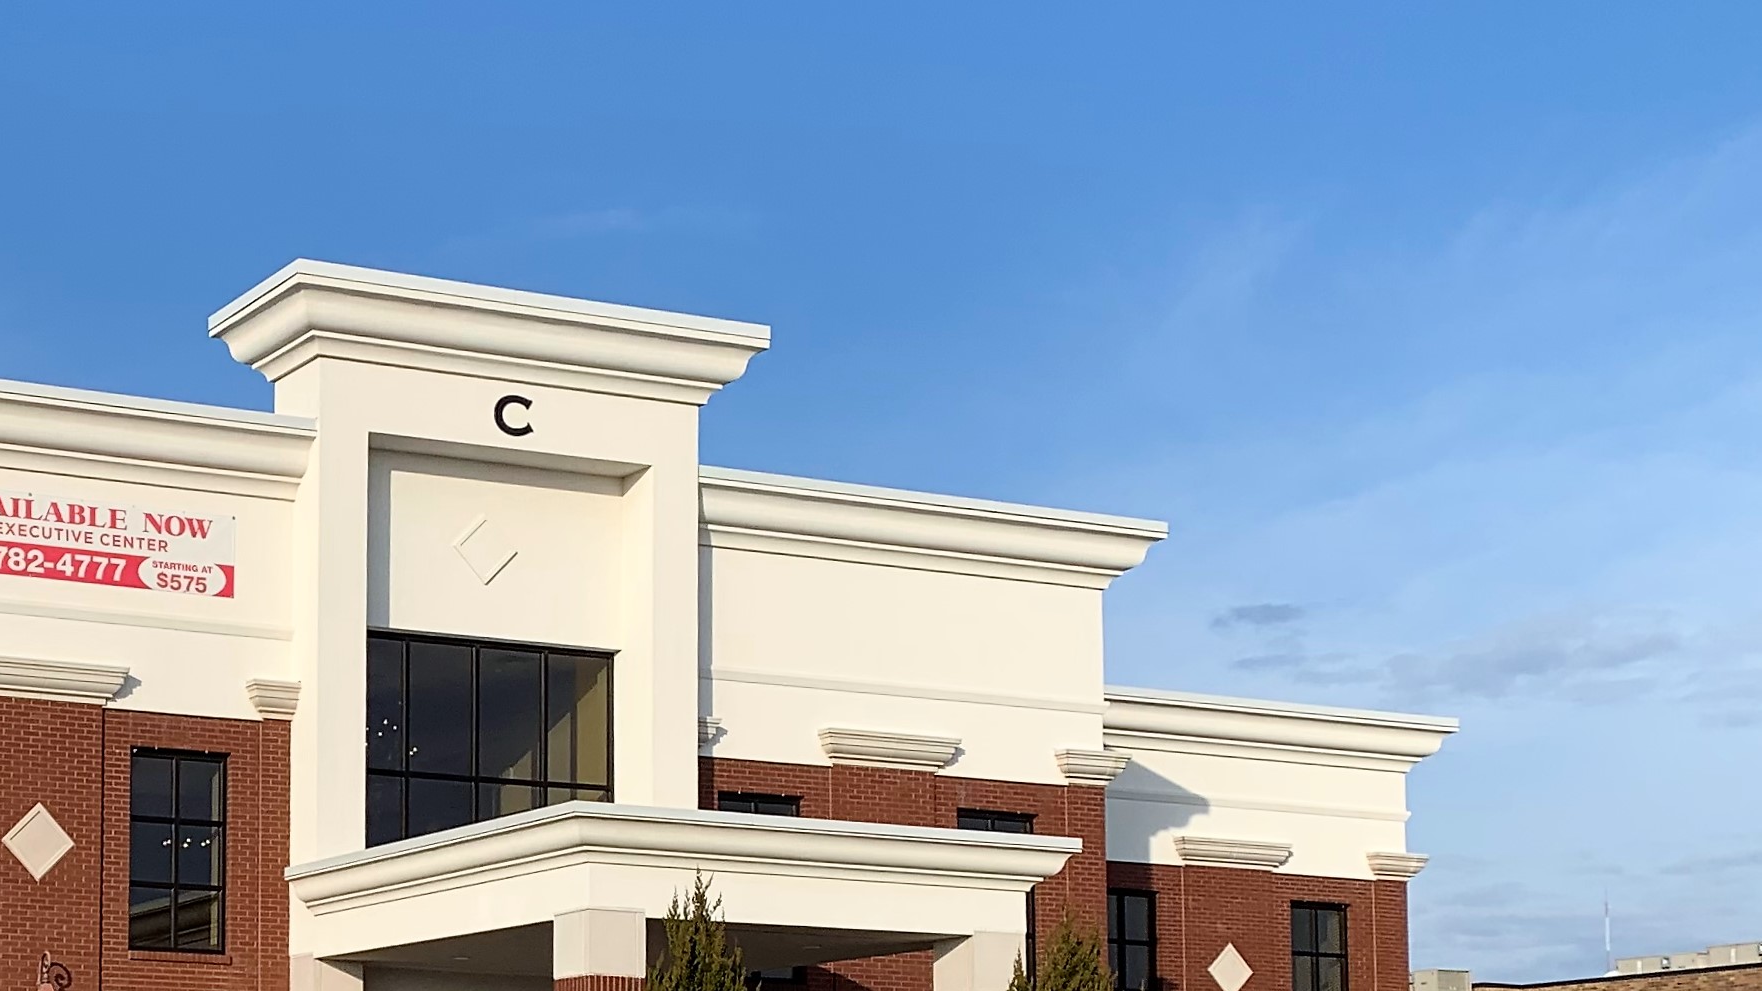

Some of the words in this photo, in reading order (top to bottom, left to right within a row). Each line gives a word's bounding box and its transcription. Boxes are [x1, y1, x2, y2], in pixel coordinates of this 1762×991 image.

[494, 394, 534, 437] C
[142, 512, 213, 540] NOW
[100, 533, 169, 552] CENTER
[152, 560, 198, 573] STARTING
[201, 565, 213, 574] AT
[156, 571, 208, 594] $575
